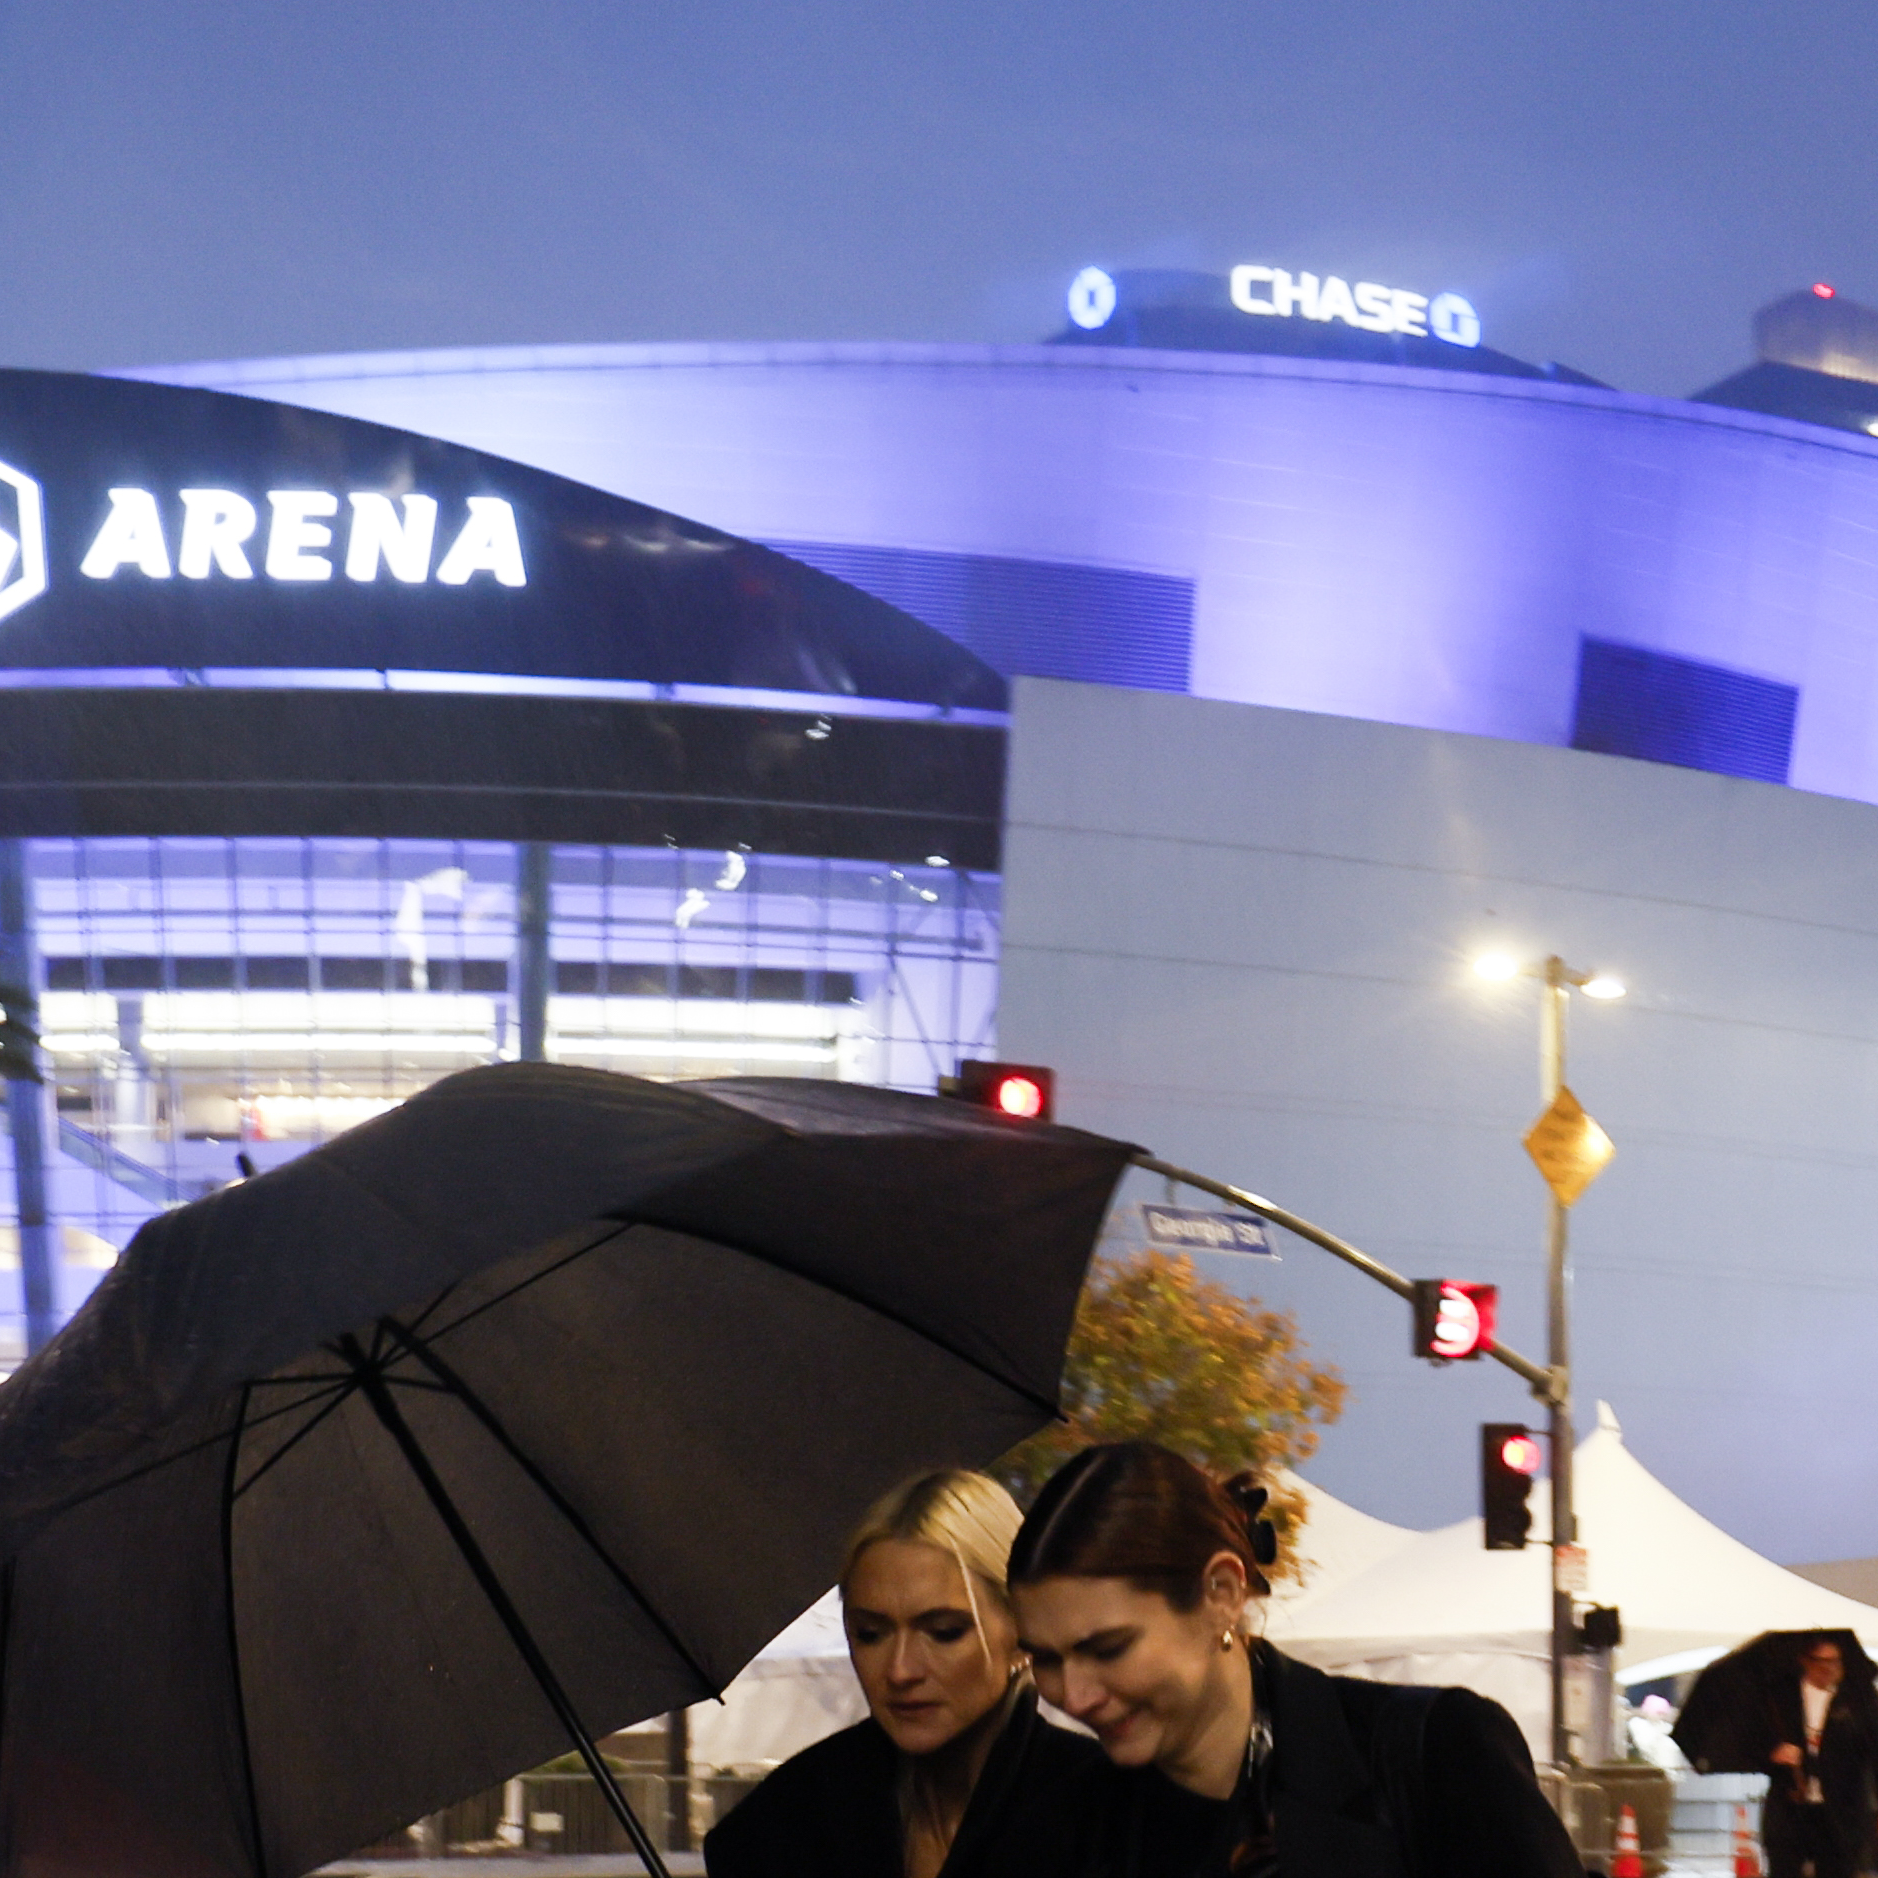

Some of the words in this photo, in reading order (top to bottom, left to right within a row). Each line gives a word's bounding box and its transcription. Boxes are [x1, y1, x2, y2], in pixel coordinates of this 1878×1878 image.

[1230, 264, 1430, 338] CHASE
[79, 486, 529, 588] ARENA
[1149, 1211, 1236, 1247] Georgia
[1234, 1222, 1267, 1246] St
